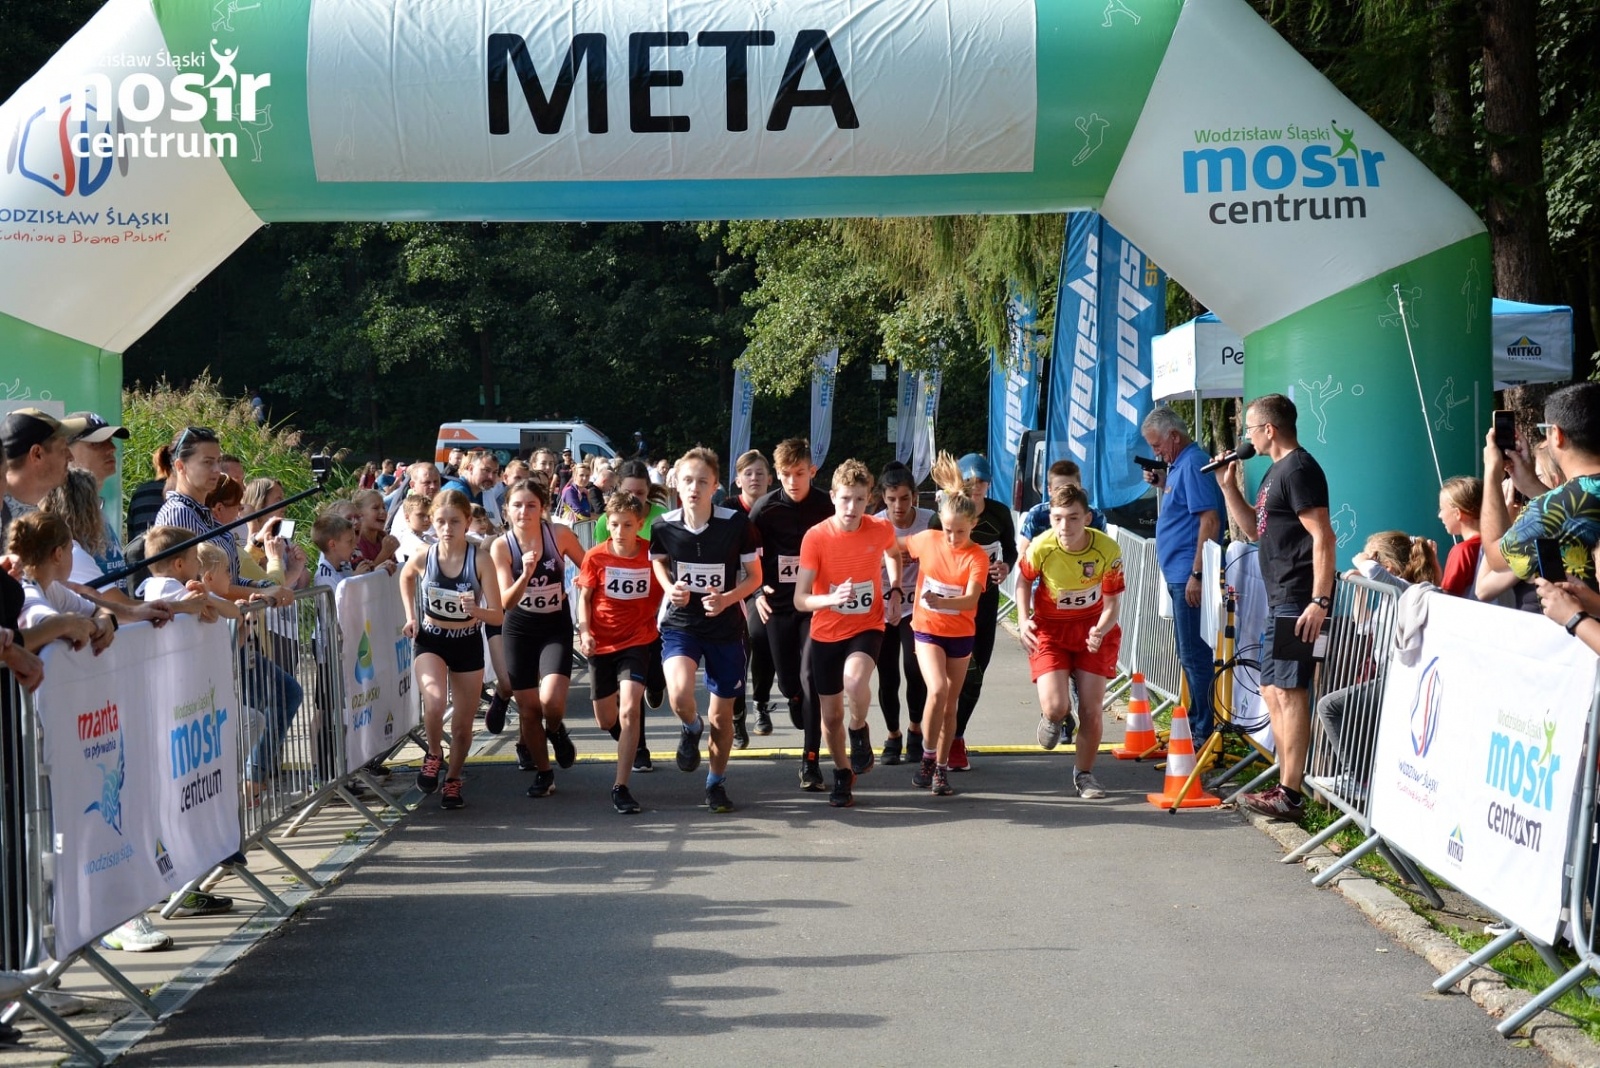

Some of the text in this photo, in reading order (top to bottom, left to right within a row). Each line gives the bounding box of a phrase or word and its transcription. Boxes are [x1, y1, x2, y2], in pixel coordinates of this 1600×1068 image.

[487, 29, 860, 135] META
[1194, 122, 1331, 145] Wodzisław Śląski
[1183, 140, 1386, 194] mosir
[106, 207, 170, 229] ŚLĄSKI
[1208, 190, 1367, 225] centrum
[72, 230, 120, 244] Brama
[1506, 346, 1542, 357] MITKO
[606, 578, 648, 594] 468
[680, 572, 722, 588] 458
[520, 593, 560, 609] 464
[1059, 590, 1098, 606] 451
[445, 626, 476, 639] NIKE
[77, 699, 119, 741] manta
[170, 708, 228, 780] mosir
[1485, 731, 1561, 812] mosir
[180, 768, 223, 813] centrum
[1487, 801, 1543, 852] centrum
